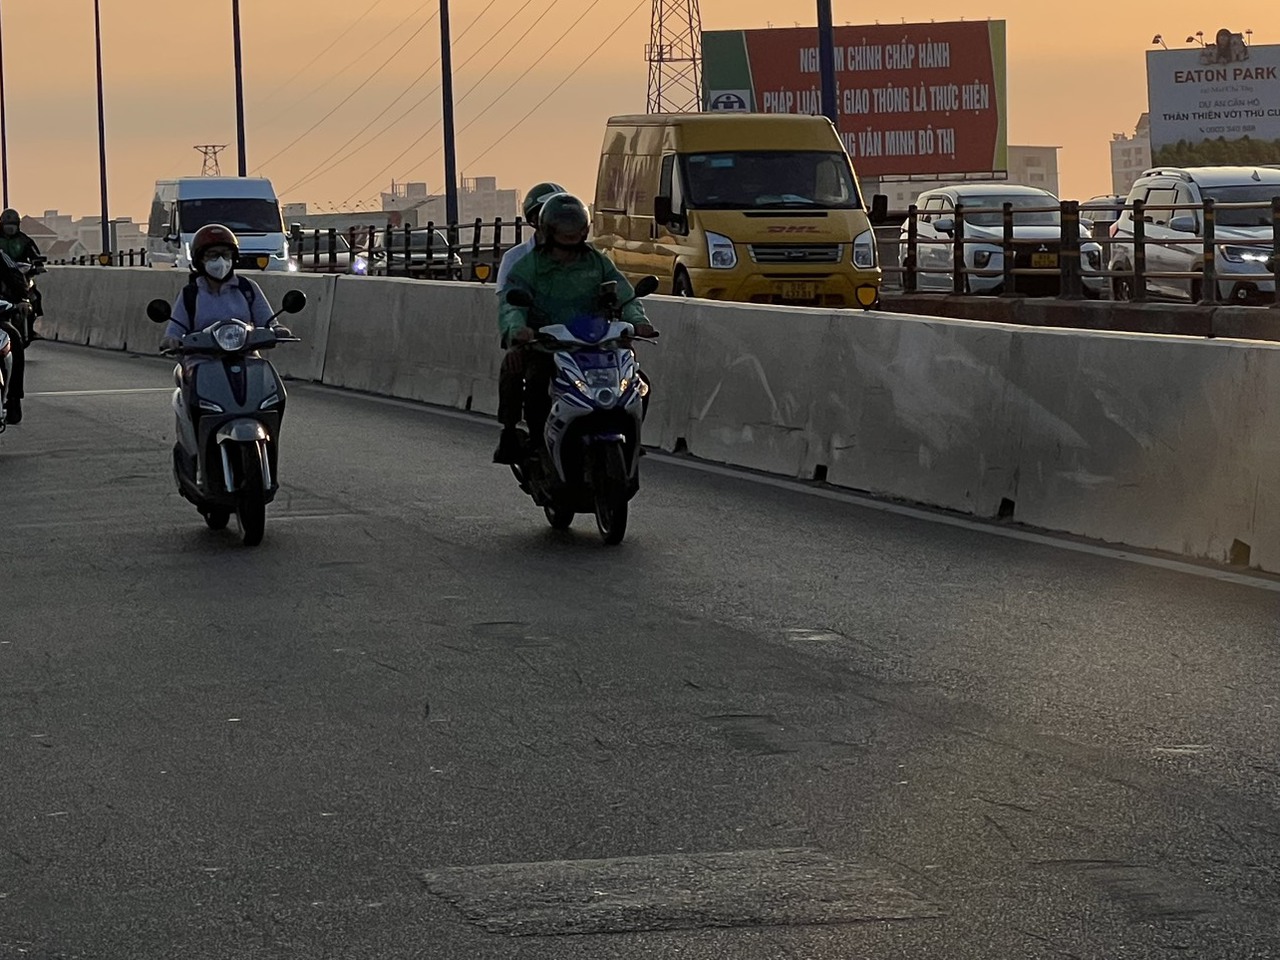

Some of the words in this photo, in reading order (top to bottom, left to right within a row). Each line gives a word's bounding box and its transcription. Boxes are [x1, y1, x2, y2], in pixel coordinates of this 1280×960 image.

[885, 34, 915, 69] CHẤP
[918, 36, 950, 68] HÀNH
[1174, 69, 1227, 83] EATON
[1233, 67, 1277, 81] PARK
[763, 85, 793, 113] PHÁP
[843, 87, 870, 115] GIAO
[872, 82, 910, 113] THÔNG
[913, 81, 927, 112] LÀ
[929, 82, 959, 117] THỰC
[962, 78, 989, 115] HIỆN
[858, 126, 882, 157] VĂN
[885, 129, 916, 156] MINH
[936, 127, 955, 159] THỊ
